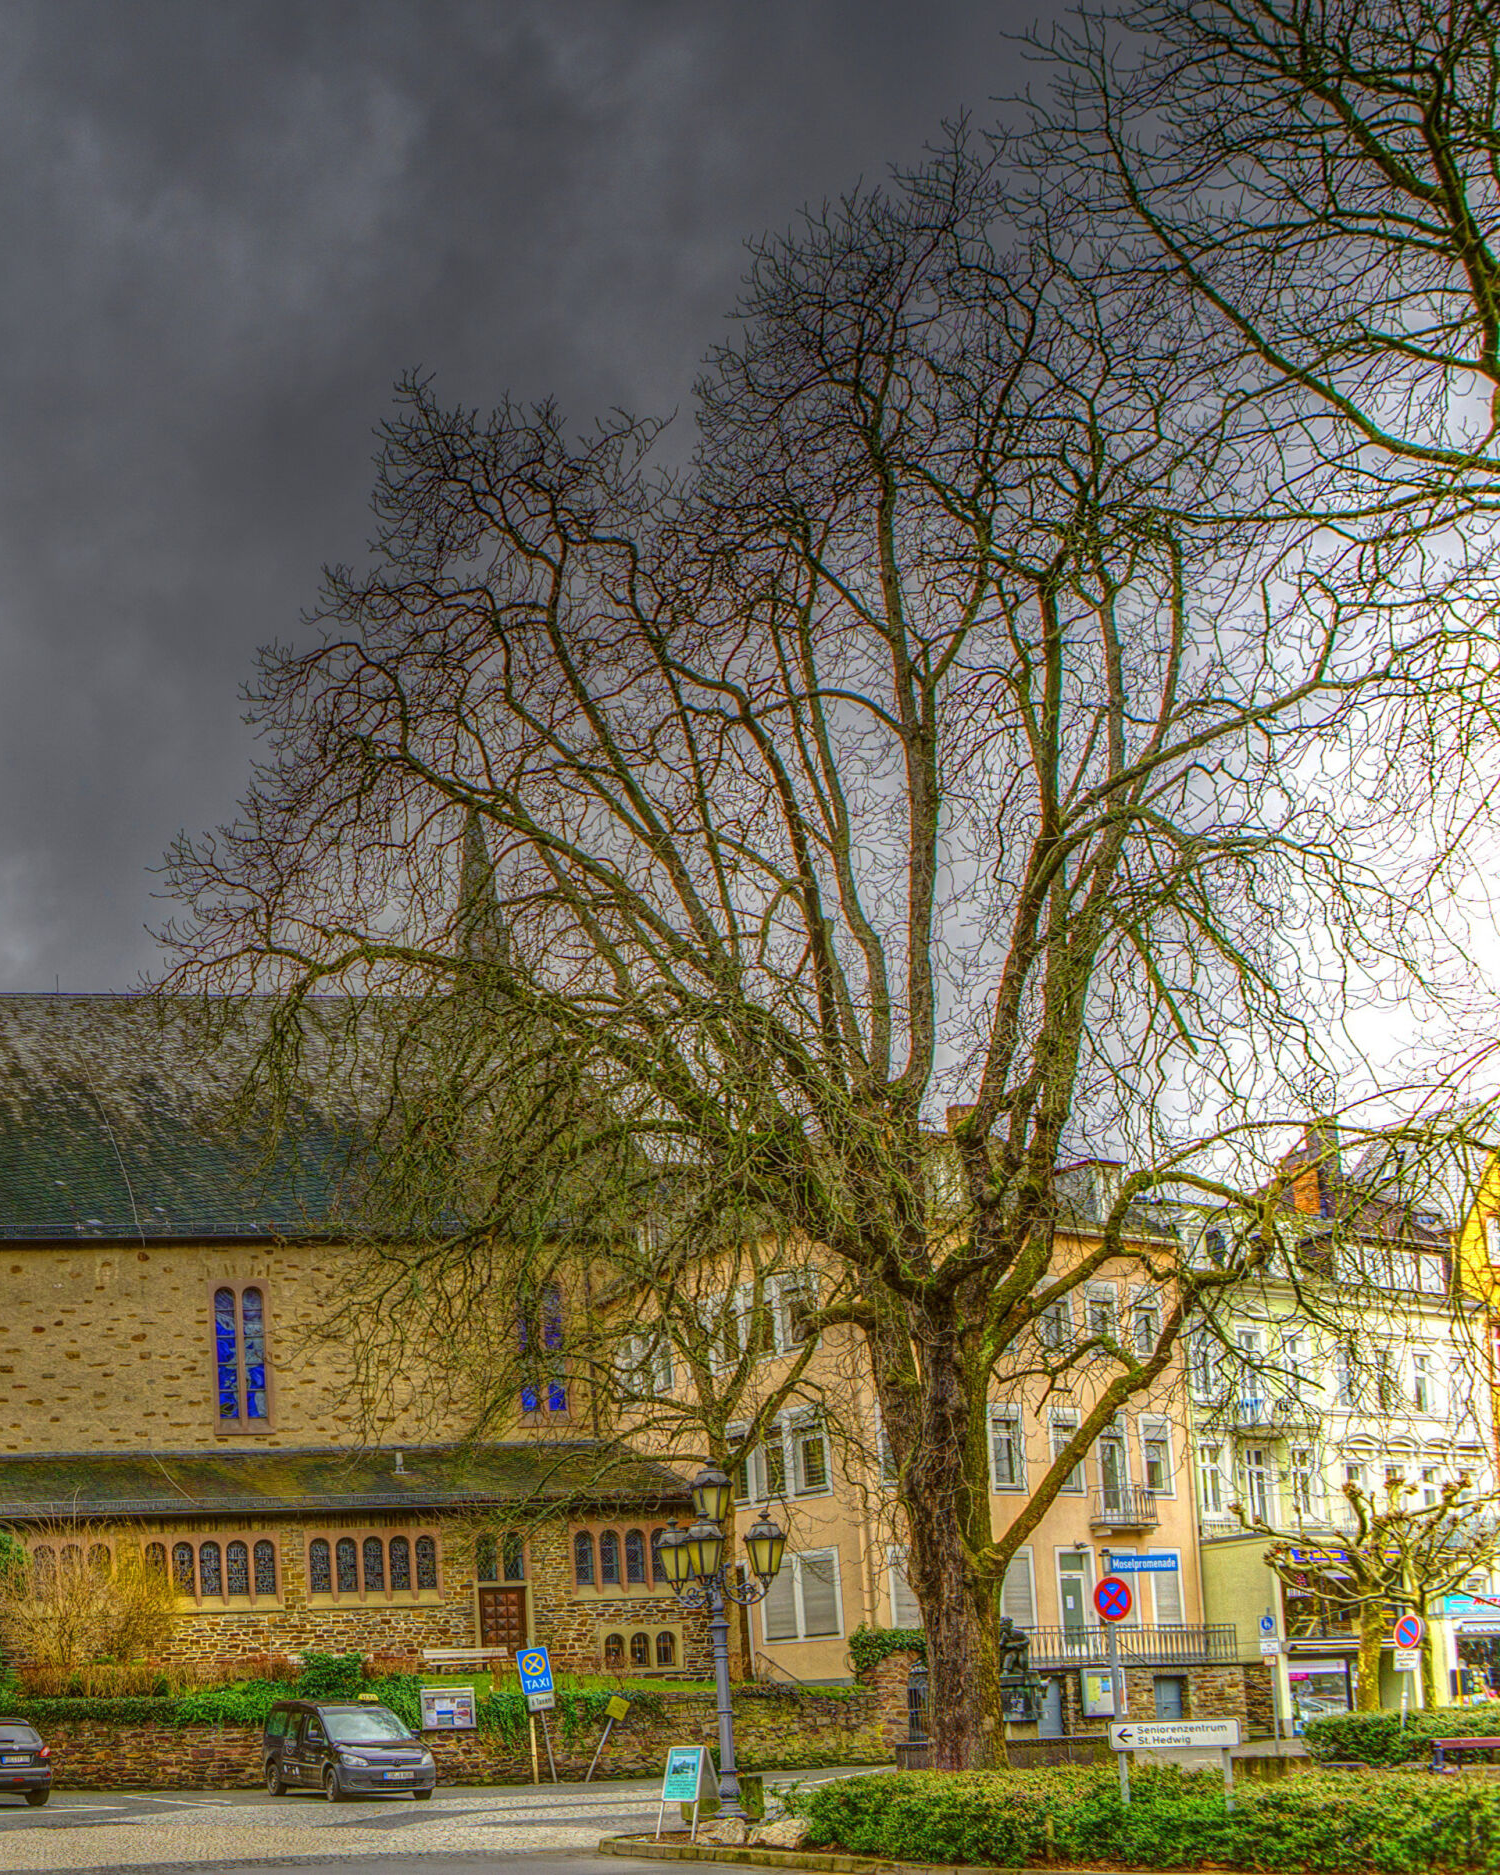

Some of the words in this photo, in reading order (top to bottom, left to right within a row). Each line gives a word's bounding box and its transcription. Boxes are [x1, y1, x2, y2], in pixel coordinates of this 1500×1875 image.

[1112, 1557, 1176, 1571] Moselpromenade
[525, 1677, 550, 1690] TAXI
[1136, 1724, 1228, 1734] Seniorenzentrum
[1138, 1736, 1151, 1745] St.
[1152, 1734, 1192, 1745] Hedwig
